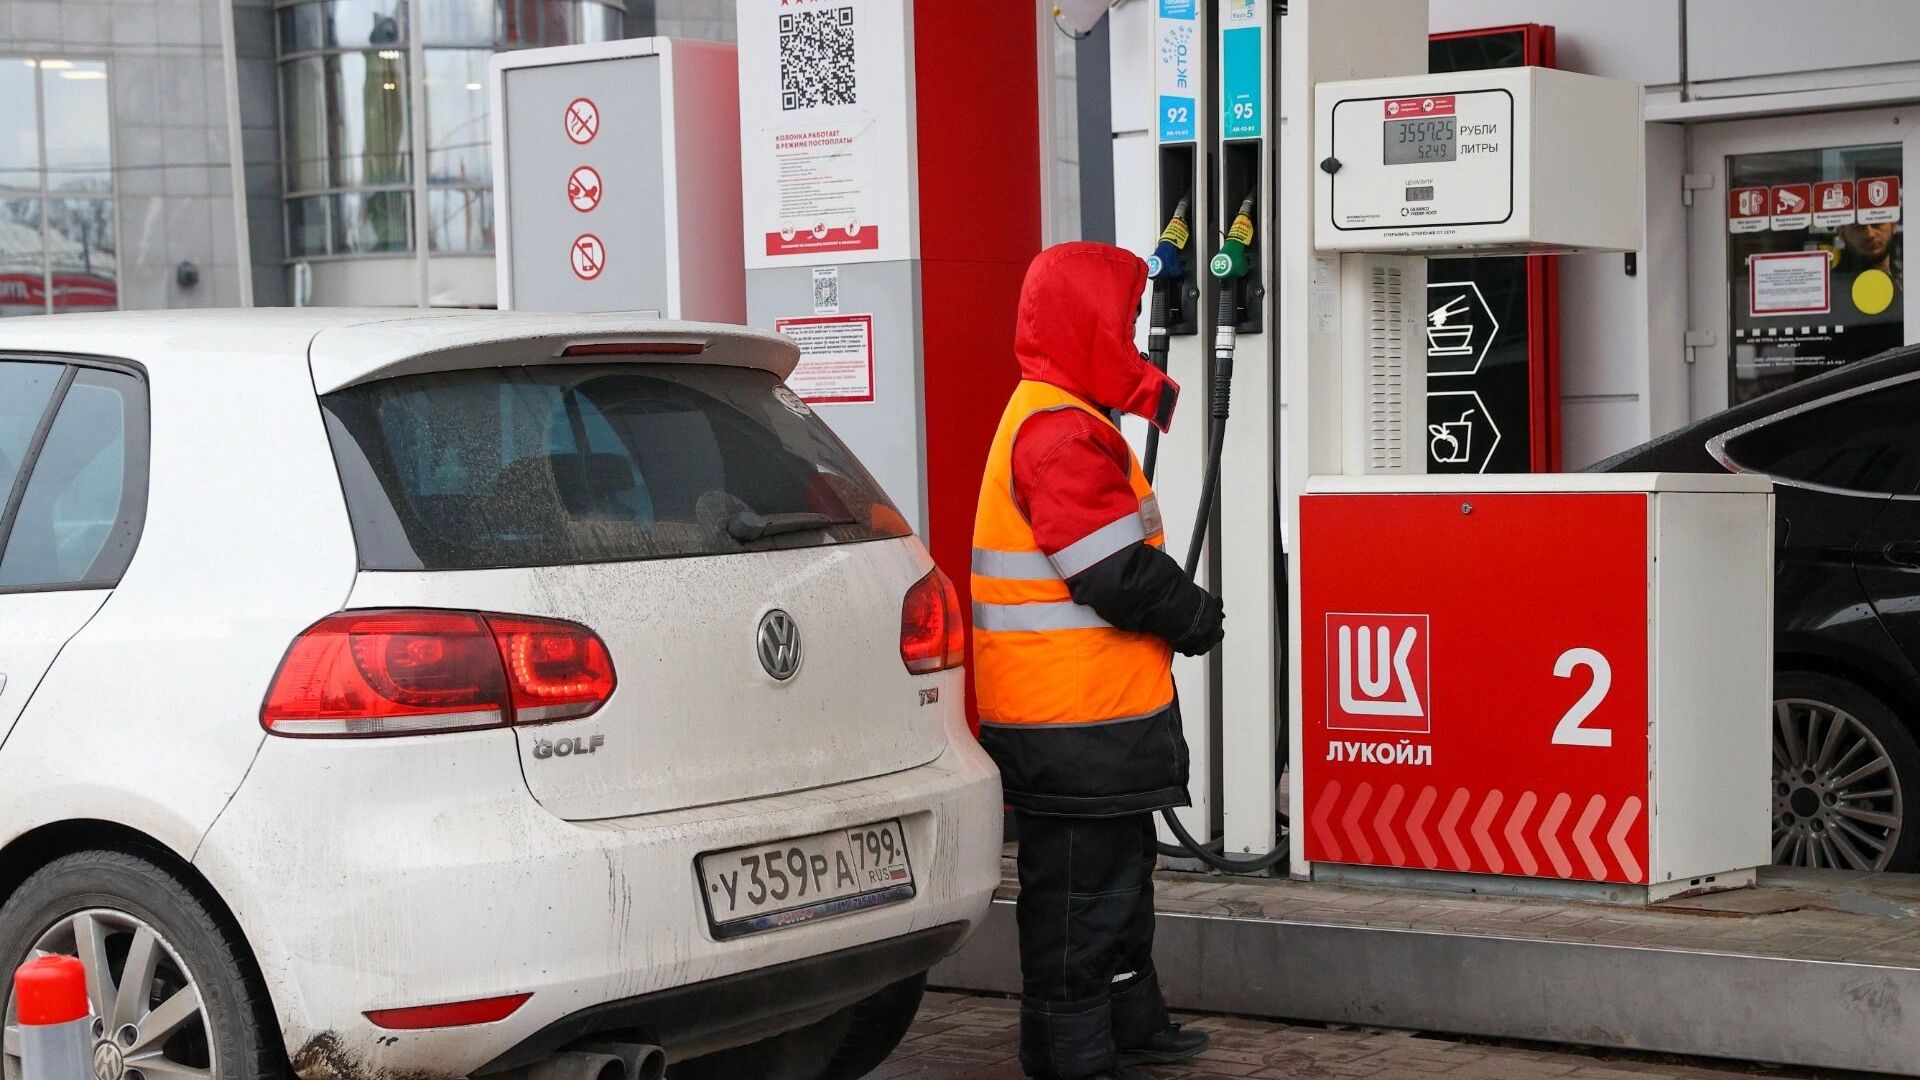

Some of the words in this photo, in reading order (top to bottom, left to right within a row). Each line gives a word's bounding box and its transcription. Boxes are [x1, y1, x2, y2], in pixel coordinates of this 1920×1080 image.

[1246, 9, 1253, 18] 5
[1177, 44, 1188, 89] ЭКТО
[1167, 107, 1188, 123] 92
[1233, 102, 1254, 119] 95
[776, 133, 807, 141] КОЛОНКА
[808, 130, 840, 139] РАБОТАЕТ
[1460, 124, 1497, 136] РУБЛИ
[808, 137, 853, 147] ПОСТОПЛАТЫ
[1460, 143, 1499, 155] ЛИТРЫ
[1214, 259, 1227, 270] 95
[919, 687, 939, 706] TSI
[1551, 647, 1612, 747] 2
[532, 734, 605, 760] GOLF
[1326, 739, 1432, 766] ЛУКОЙЛ
[851, 828, 894, 870] 799
[869, 867, 890, 884] RUS
